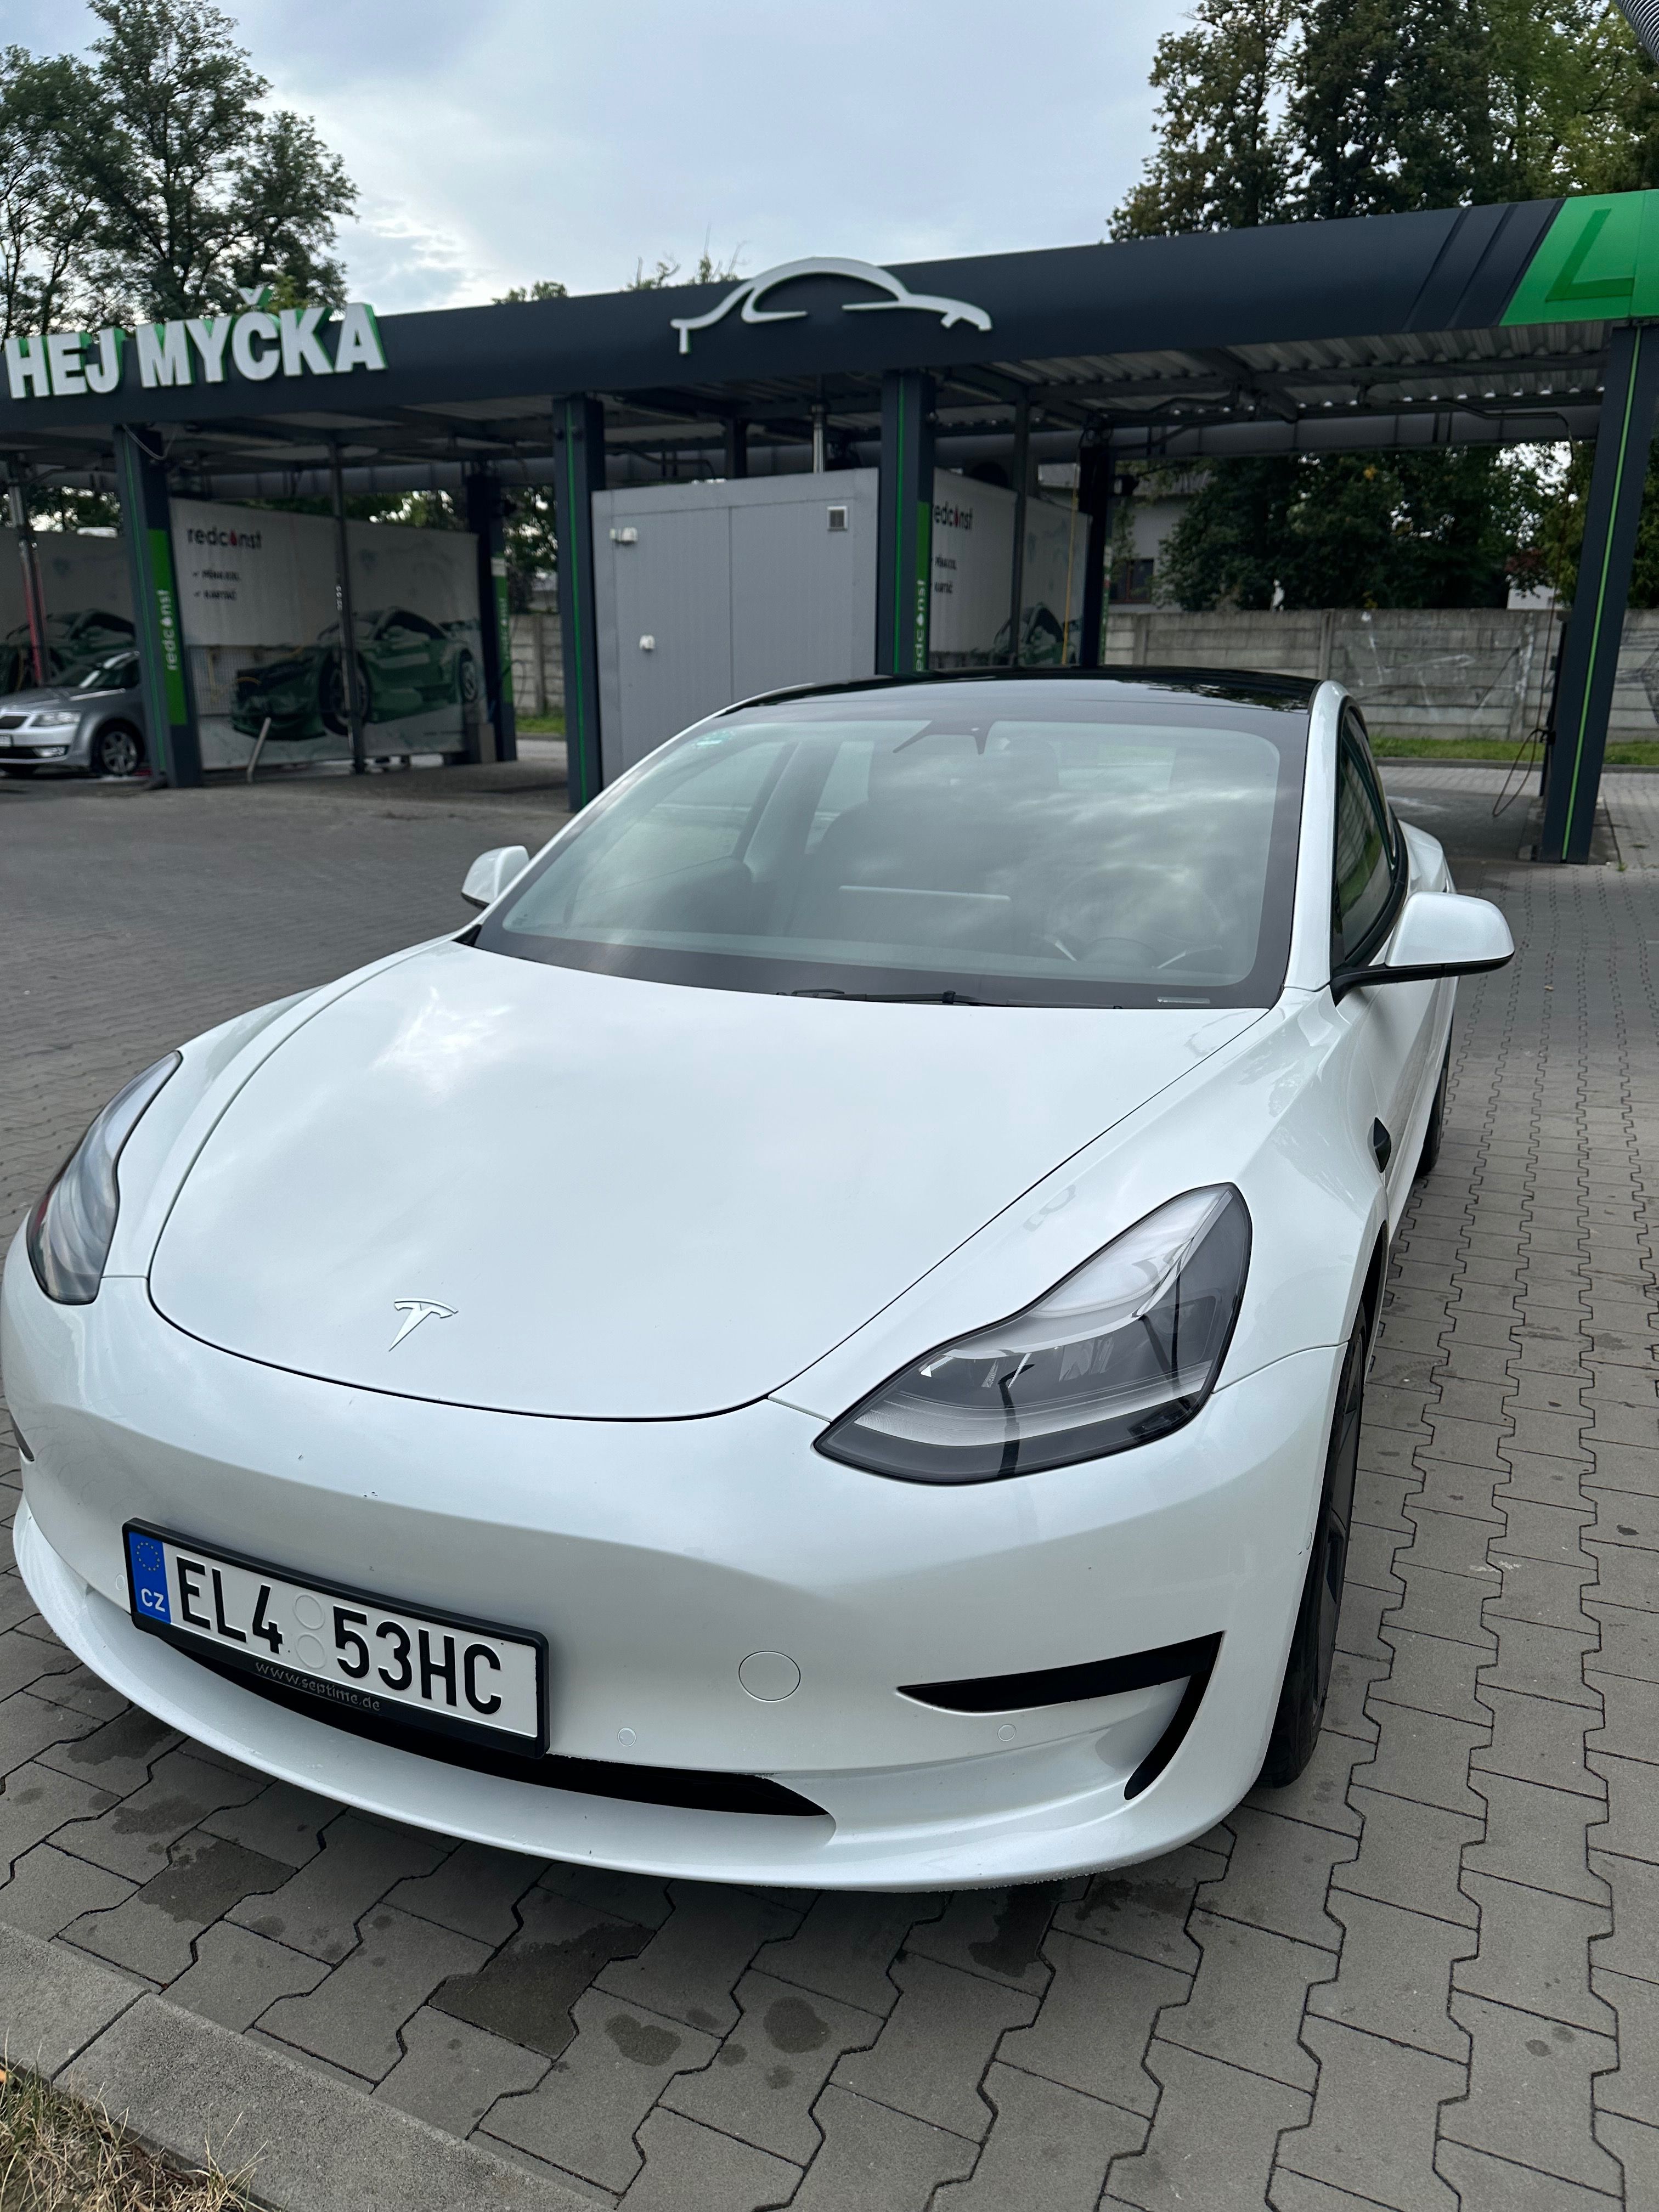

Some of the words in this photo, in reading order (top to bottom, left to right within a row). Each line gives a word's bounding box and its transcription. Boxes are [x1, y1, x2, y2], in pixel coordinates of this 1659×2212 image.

[4, 329, 125, 399] HEJ
[136, 287, 388, 388] MYČKA
[140, 1587, 167, 1613] CZ
[176, 1555, 284, 1655] EL4
[332, 1604, 503, 1716] 53HC
[255, 1662, 381, 1712] www.septime.de
